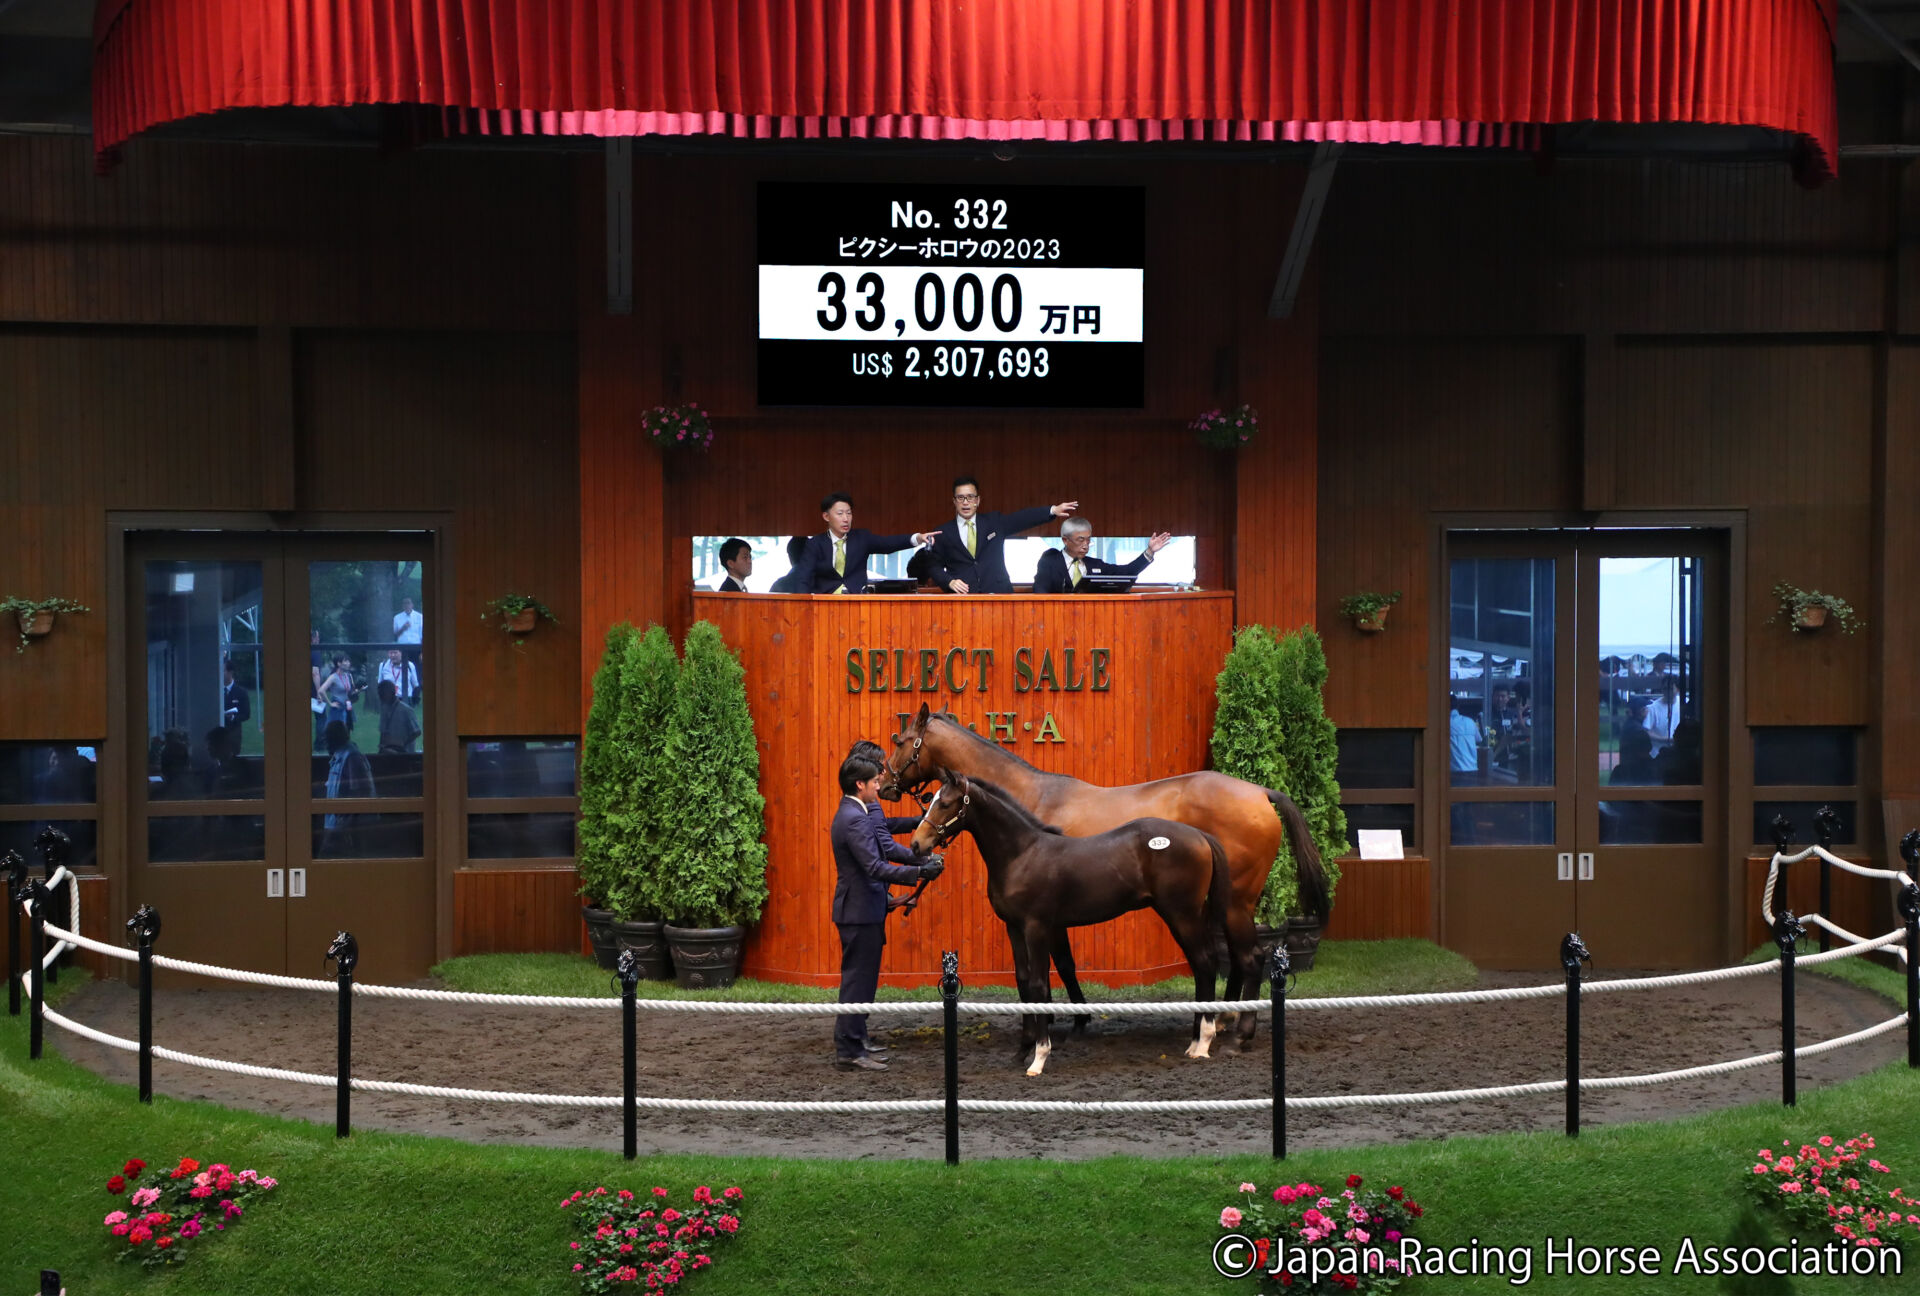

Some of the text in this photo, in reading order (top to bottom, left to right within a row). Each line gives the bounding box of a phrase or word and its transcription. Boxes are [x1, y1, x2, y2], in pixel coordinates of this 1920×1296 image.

[892, 198, 1008, 230] No. 332
[839, 236, 1061, 260] ピクシーホロウの2023
[816, 271, 1102, 338] 33,000 万円
[852, 346, 1050, 380] US$ 2,307,693
[846, 646, 1111, 693] SELECT SALE
